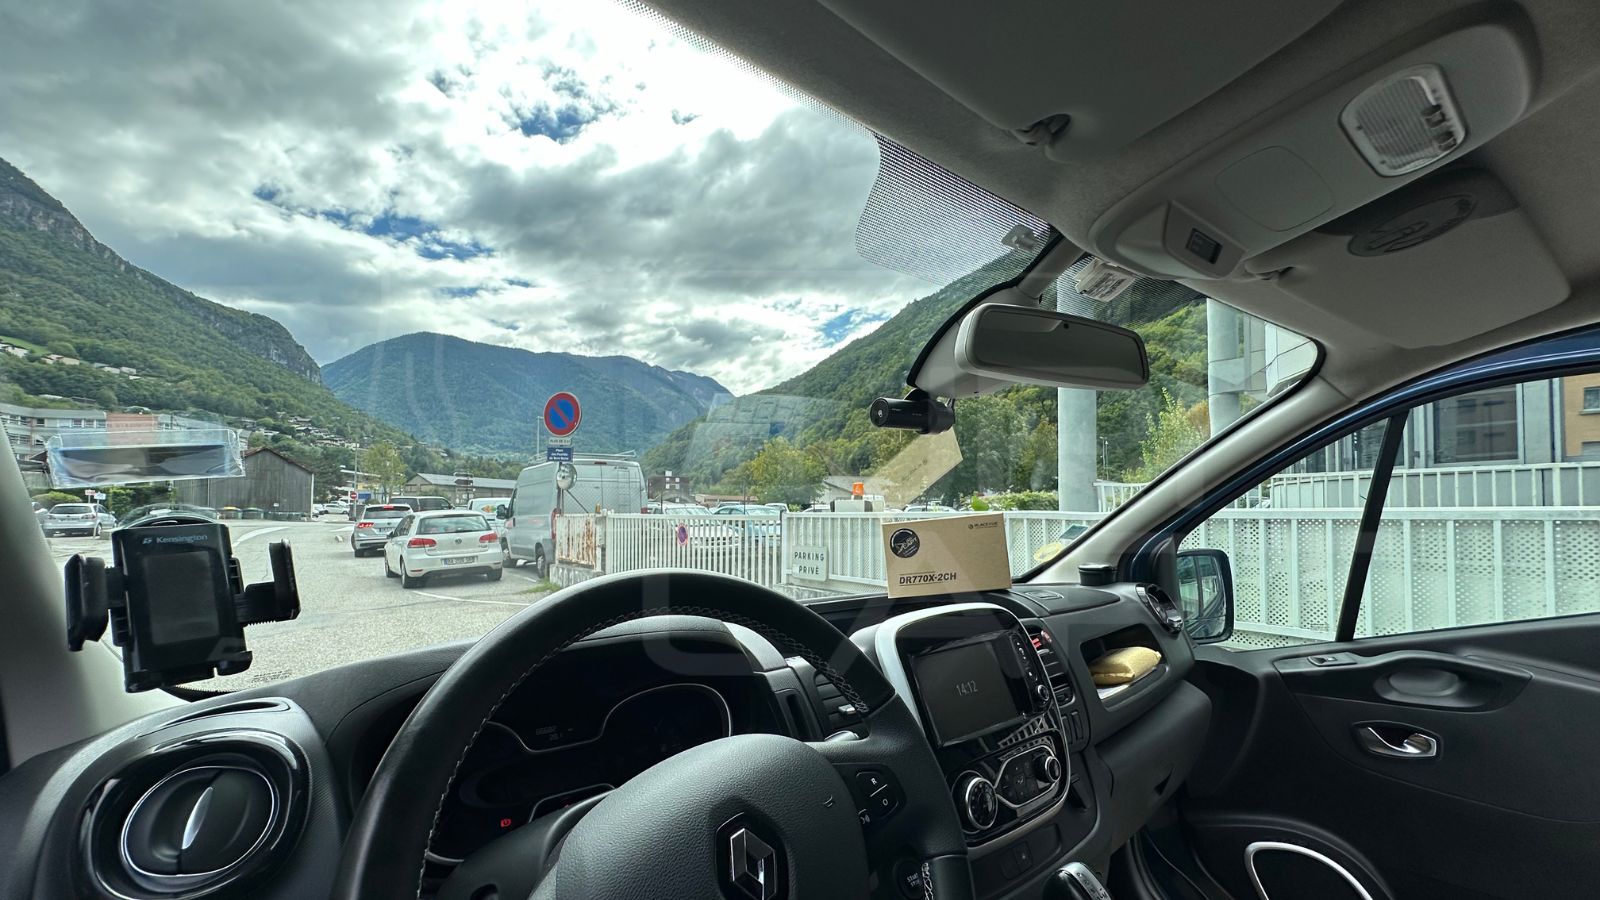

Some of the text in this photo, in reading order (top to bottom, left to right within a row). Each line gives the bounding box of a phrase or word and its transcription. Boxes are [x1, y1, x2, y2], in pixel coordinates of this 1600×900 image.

[156, 535, 208, 543] Kensington
[794, 552, 824, 561] PARKING
[899, 572, 957, 584] DR770X-2CH
[956, 679, 978, 696] 14:12
